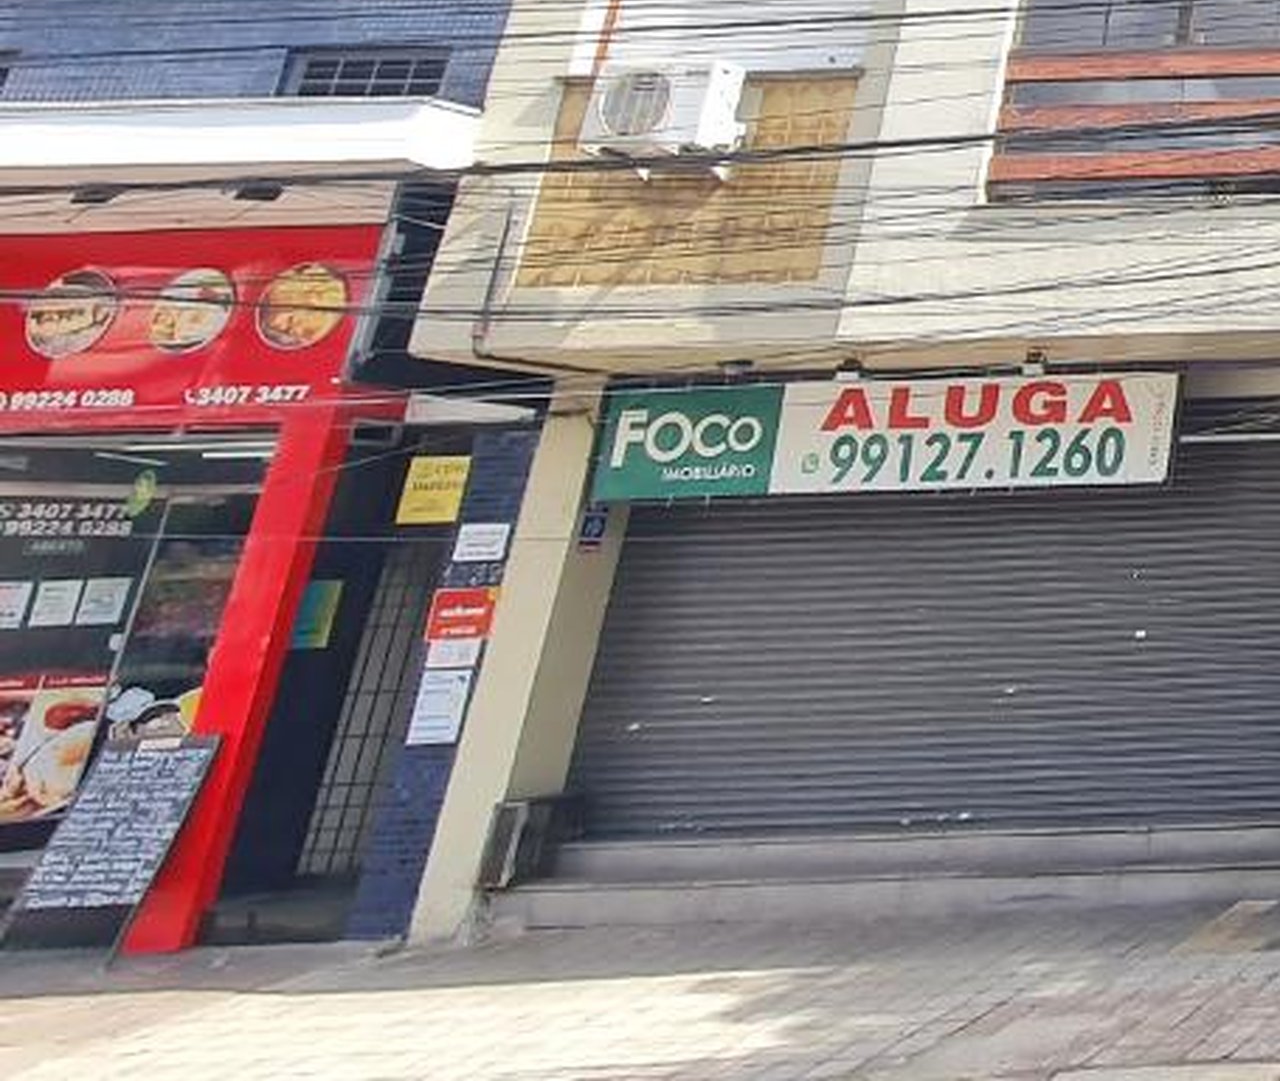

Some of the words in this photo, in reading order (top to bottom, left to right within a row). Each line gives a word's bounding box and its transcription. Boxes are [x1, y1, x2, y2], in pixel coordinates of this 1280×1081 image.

[196, 387, 250, 406] 3407
[254, 385, 311, 404] 3477
[821, 378, 1134, 432] ALUGA
[611, 407, 763, 469] FOCO
[828, 427, 1126, 486] 99127.1260
